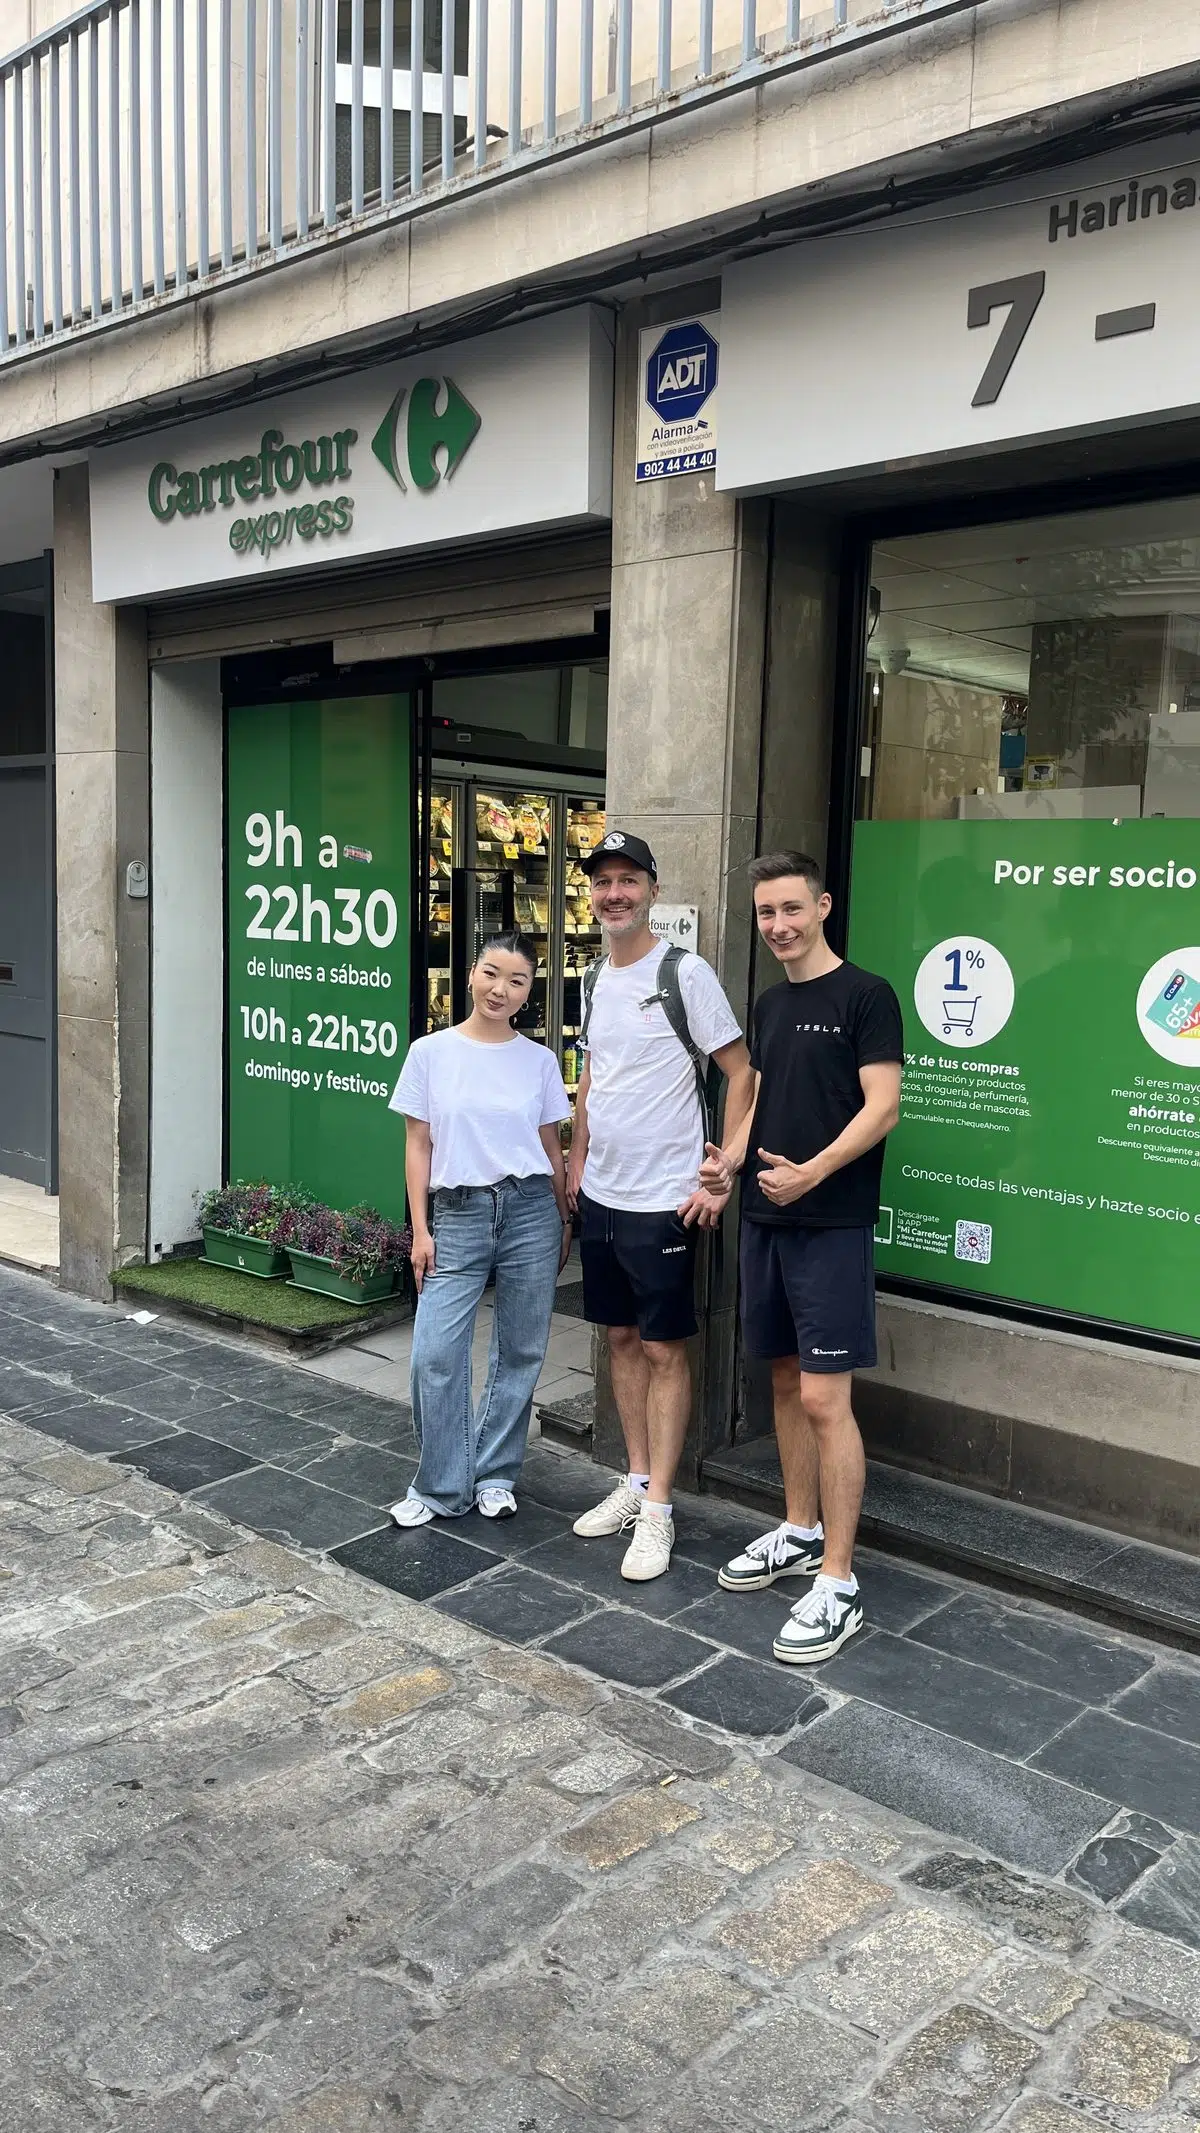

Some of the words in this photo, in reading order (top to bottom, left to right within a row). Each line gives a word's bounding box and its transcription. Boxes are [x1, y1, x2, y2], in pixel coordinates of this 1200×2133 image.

[1048, 176, 1200, 243] Harina
[967, 270, 1045, 407] 7
[657, 352, 707, 394] ADT
[651, 424, 694, 441] Alarma
[148, 428, 357, 520] Carrefour
[644, 461, 664, 476] 902
[666, 457, 681, 472] 44
[683, 455, 698, 469] 44
[699, 451, 714, 466] 40
[229, 496, 354, 557] express
[245, 810, 303, 868] 9h
[318, 834, 338, 868] a
[994, 860, 1045, 885] Por
[1052, 864, 1100, 886] ser
[1108, 860, 1197, 889] socio
[245, 883, 398, 948] 22h30
[650, 918, 670, 930] four
[246, 956, 266, 977] de
[270, 957, 312, 981] lunes
[316, 966, 325, 982] a
[330, 963, 392, 988] sábado
[944, 949, 985, 991] 1%
[240, 1005, 286, 1043] 10h
[291, 1027, 302, 1045] a
[306, 1013, 398, 1057] 22h30
[795, 1024, 841, 1034] TESLA
[245, 1058, 310, 1088] domingo
[313, 1072, 323, 1091] y
[326, 1069, 388, 1097] festivos
[920, 1055, 935, 1067] de
[938, 1056, 958, 1070] tus
[961, 1060, 1020, 1076] compras
[907, 1069, 967, 1084] alimentación
[968, 1078, 976, 1086] y
[976, 1079, 1026, 1091] productos
[1134, 1076, 1144, 1086] Si
[1146, 1079, 1170, 1089] eres
[900, 1093, 923, 1103] pieza
[924, 1096, 932, 1106] y
[932, 1097, 967, 1109] comida
[969, 1101, 981, 1110] de
[983, 1103, 1032, 1117] mascotas.
[901, 1082, 922, 1092] scos,
[924, 1083, 972, 1098] droguería,
[973, 1090, 1030, 1105] perfumería,
[1111, 1088, 1147, 1100] menor
[1149, 1092, 1164, 1101] de
[1165, 1092, 1180, 1103] 30
[1182, 1096, 1190, 1104] o
[902, 1111, 945, 1124] Acumulable
[956, 1119, 1012, 1132] ChequeAhorro.
[1128, 1104, 1195, 1123] ahórrate
[1126, 1122, 1140, 1131] en
[1143, 1124, 1200, 1139] productos
[1097, 1136, 1142, 1149] Descuento
[1143, 1142, 1193, 1156] equivalente
[1143, 1152, 1189, 1166] Descuento
[1190, 1159, 1200, 1167] di
[901, 1164, 953, 1184] Conoce
[956, 1174, 995, 1191] todas
[998, 1179, 1018, 1195] las
[1021, 1185, 1084, 1206] ventajas
[1086, 1196, 1096, 1210] y
[1099, 1195, 1144, 1215] hazte
[1147, 1206, 1190, 1222] socio
[897, 1217, 904, 1225] la
